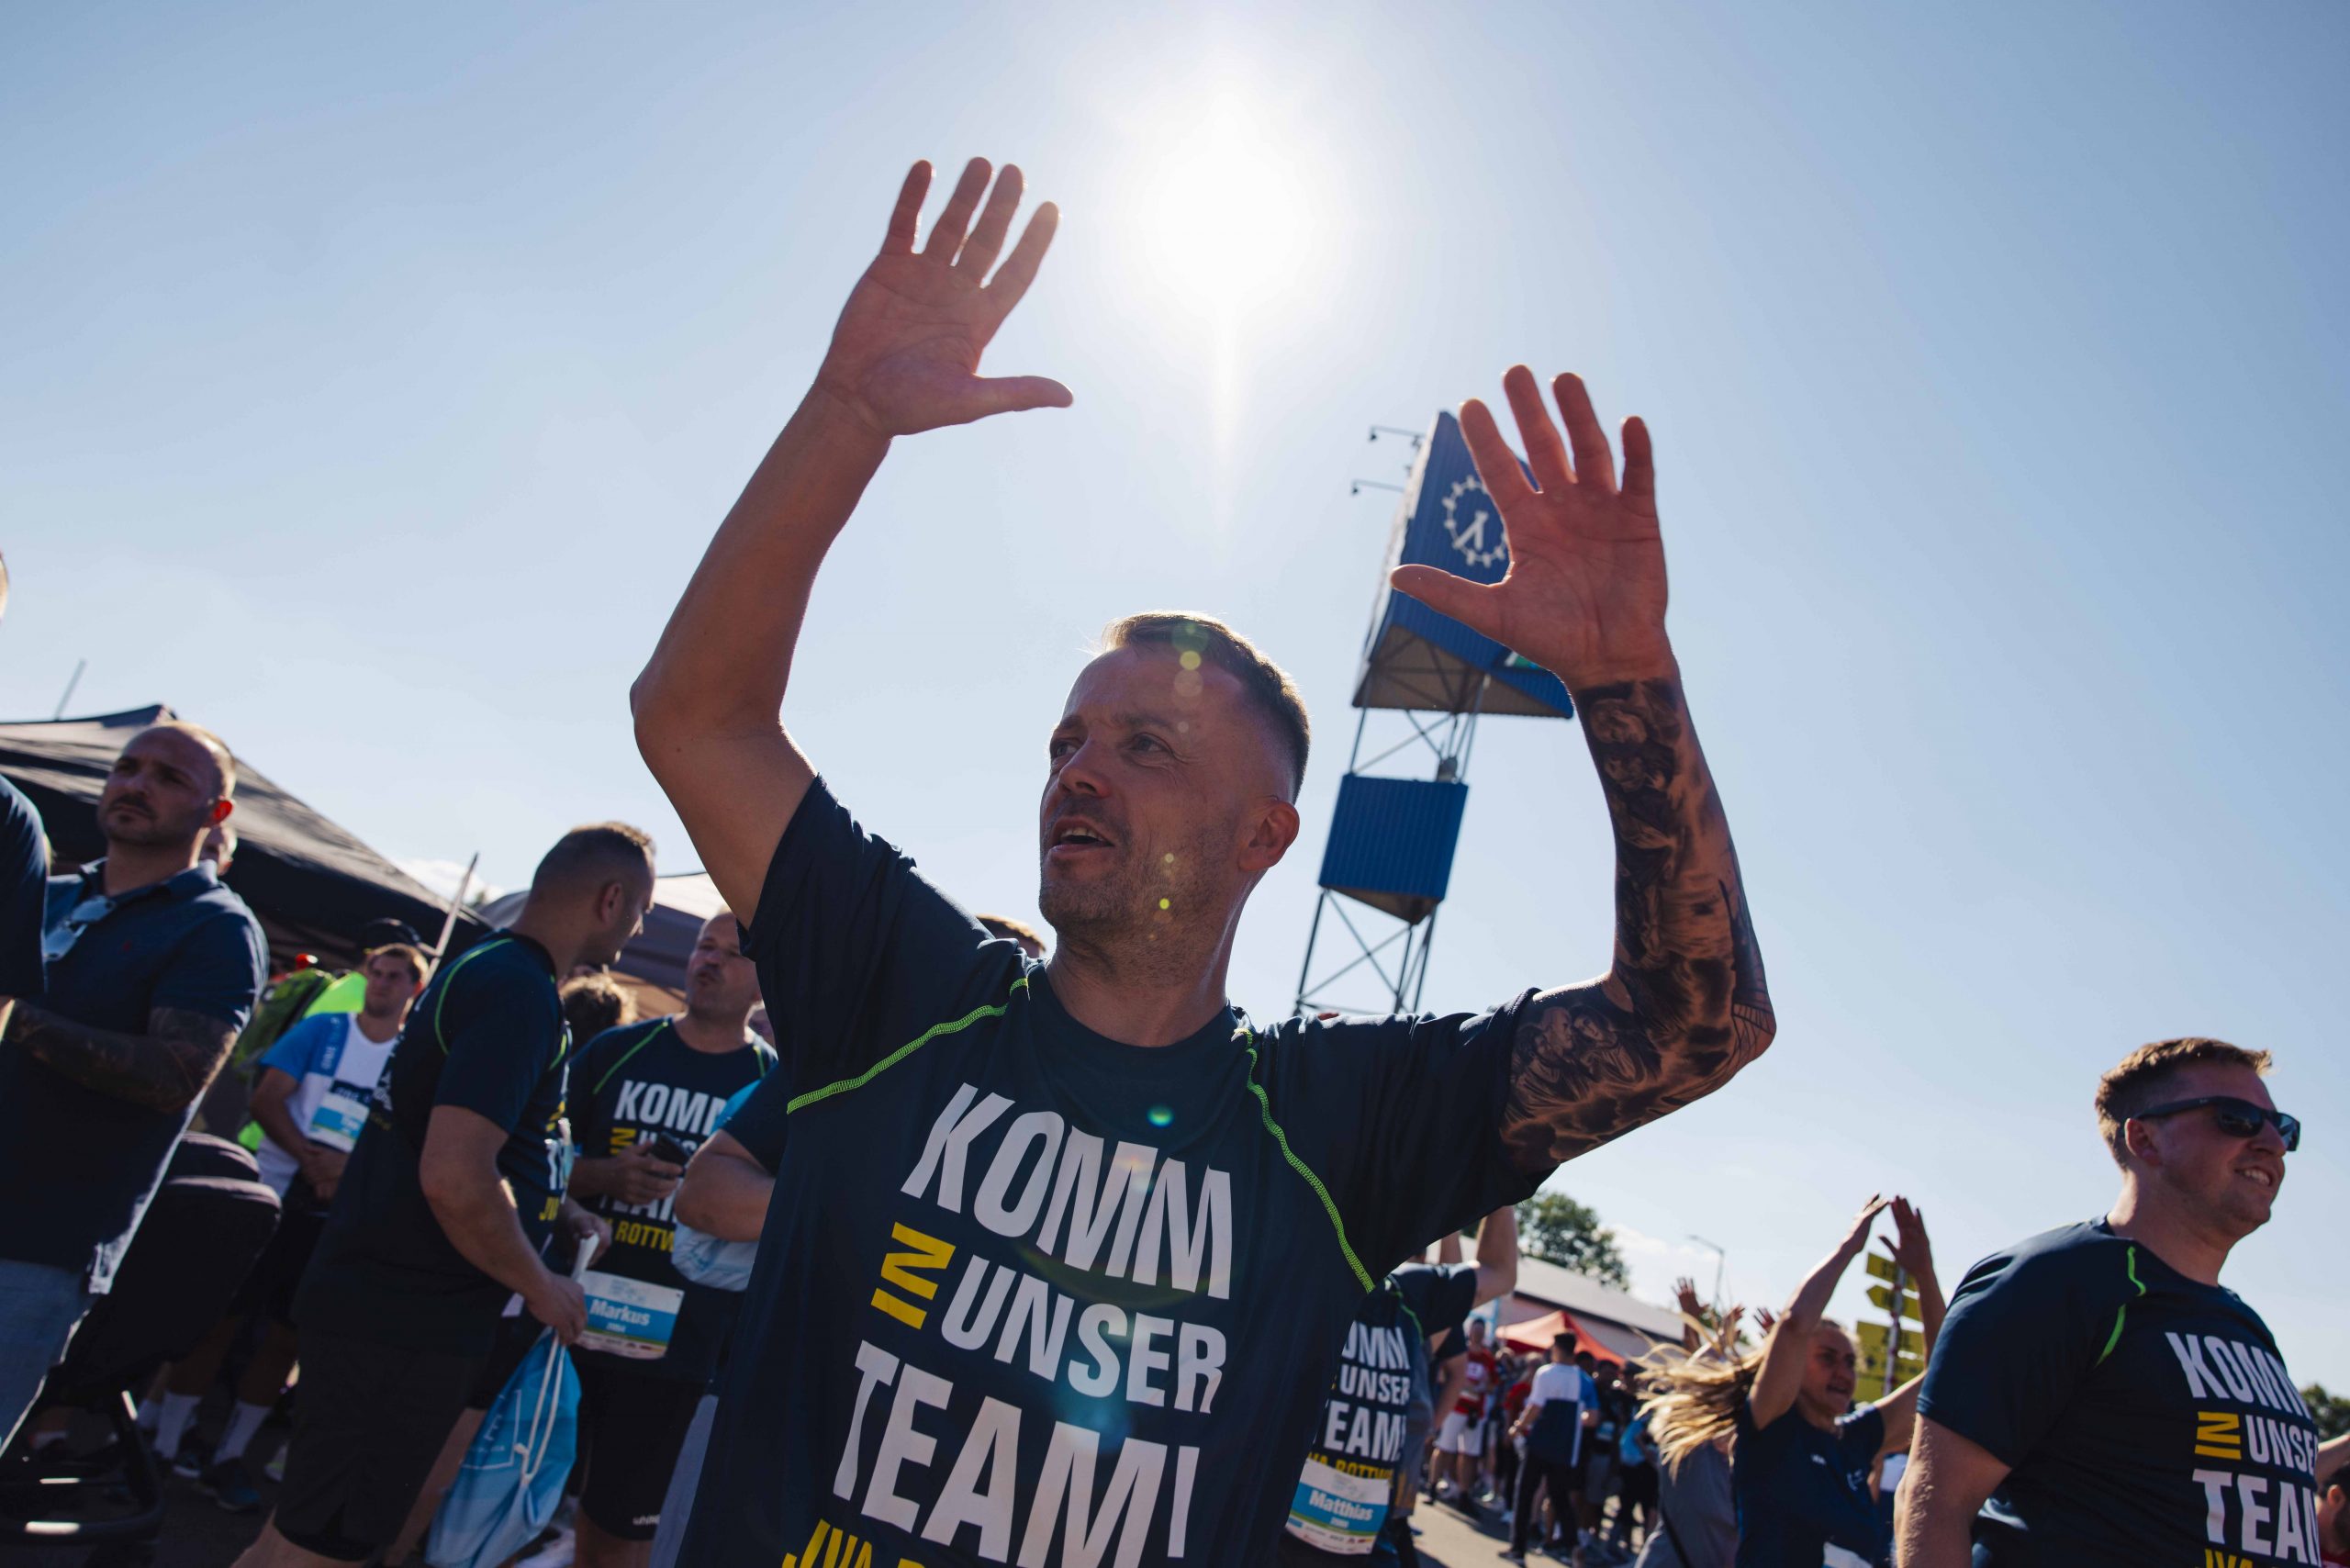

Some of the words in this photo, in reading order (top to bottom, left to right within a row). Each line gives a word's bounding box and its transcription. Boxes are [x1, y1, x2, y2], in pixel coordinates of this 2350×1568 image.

[901, 1082, 1233, 1300] KOMM
[588, 1298, 651, 1327] Markus
[871, 1222, 957, 1330] IN
[941, 1254, 1227, 1415] UNSER
[1339, 1363, 1411, 1406] UNSER
[834, 1340, 1201, 1568] TEAM!
[1323, 1399, 1407, 1462] EAM!
[2194, 1411, 2242, 1461] IN
[2245, 1415, 2319, 1476] UNSE
[1309, 1489, 1374, 1522] Matthias
